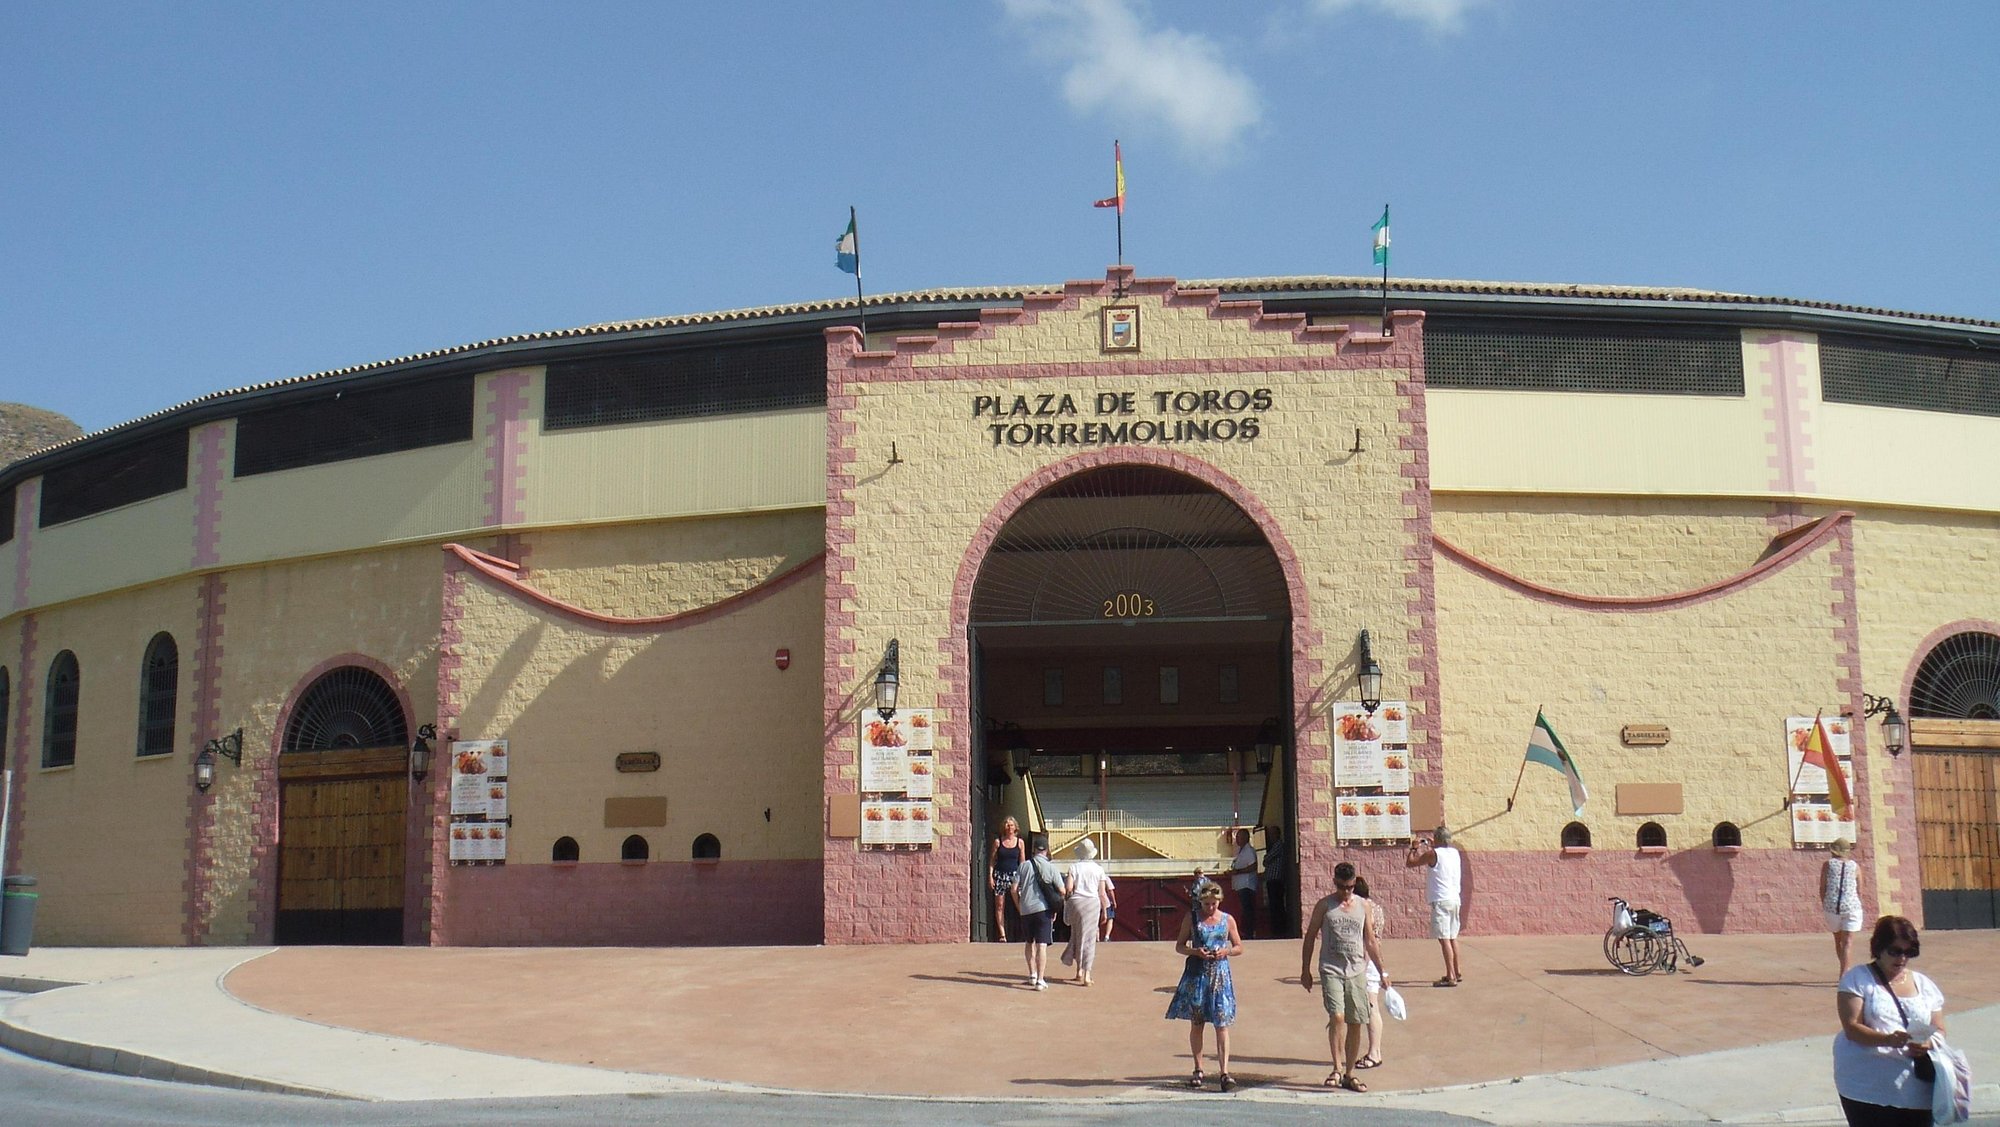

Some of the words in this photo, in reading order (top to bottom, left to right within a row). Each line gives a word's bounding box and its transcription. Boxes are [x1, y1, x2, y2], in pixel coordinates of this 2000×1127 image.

[975, 393, 1078, 416] PLAZA
[1097, 391, 1136, 414] DE
[1155, 388, 1273, 413] TOROS
[989, 417, 1261, 446] TORREMOLINOS
[1104, 594, 1153, 616] 2003
